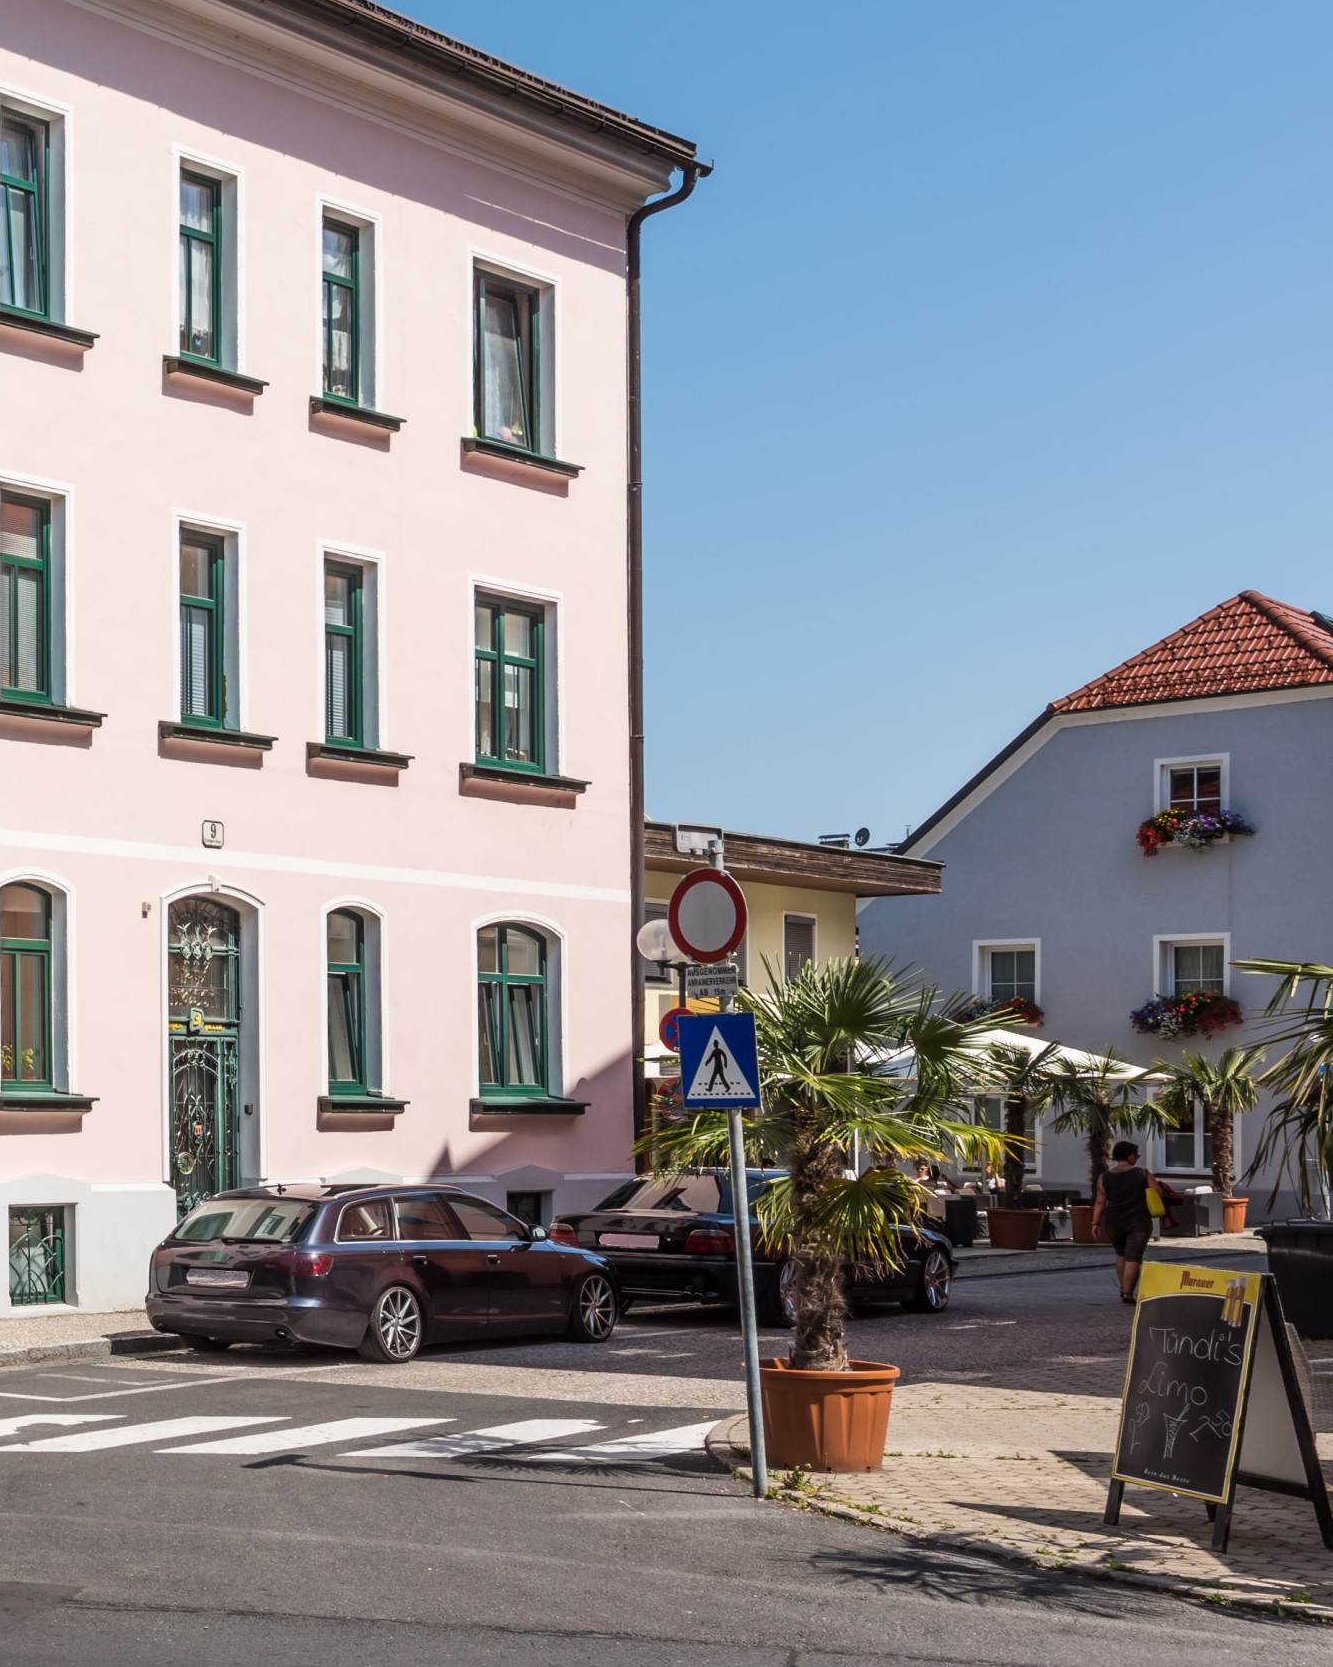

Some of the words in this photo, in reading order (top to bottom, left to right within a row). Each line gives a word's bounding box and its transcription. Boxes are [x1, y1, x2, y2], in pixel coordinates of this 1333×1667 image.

[210, 823, 217, 839] 9
[687, 965, 737, 977] AUSGENOMMEN
[687, 976, 737, 987] ANRAINERVERKEHR
[699, 988, 709, 997] AB
[713, 987, 726, 997] 15m
[1139, 1361, 1208, 1406] Limo
[1159, 1471, 1171, 1479] das
[1172, 1474, 1191, 1484] Beste
